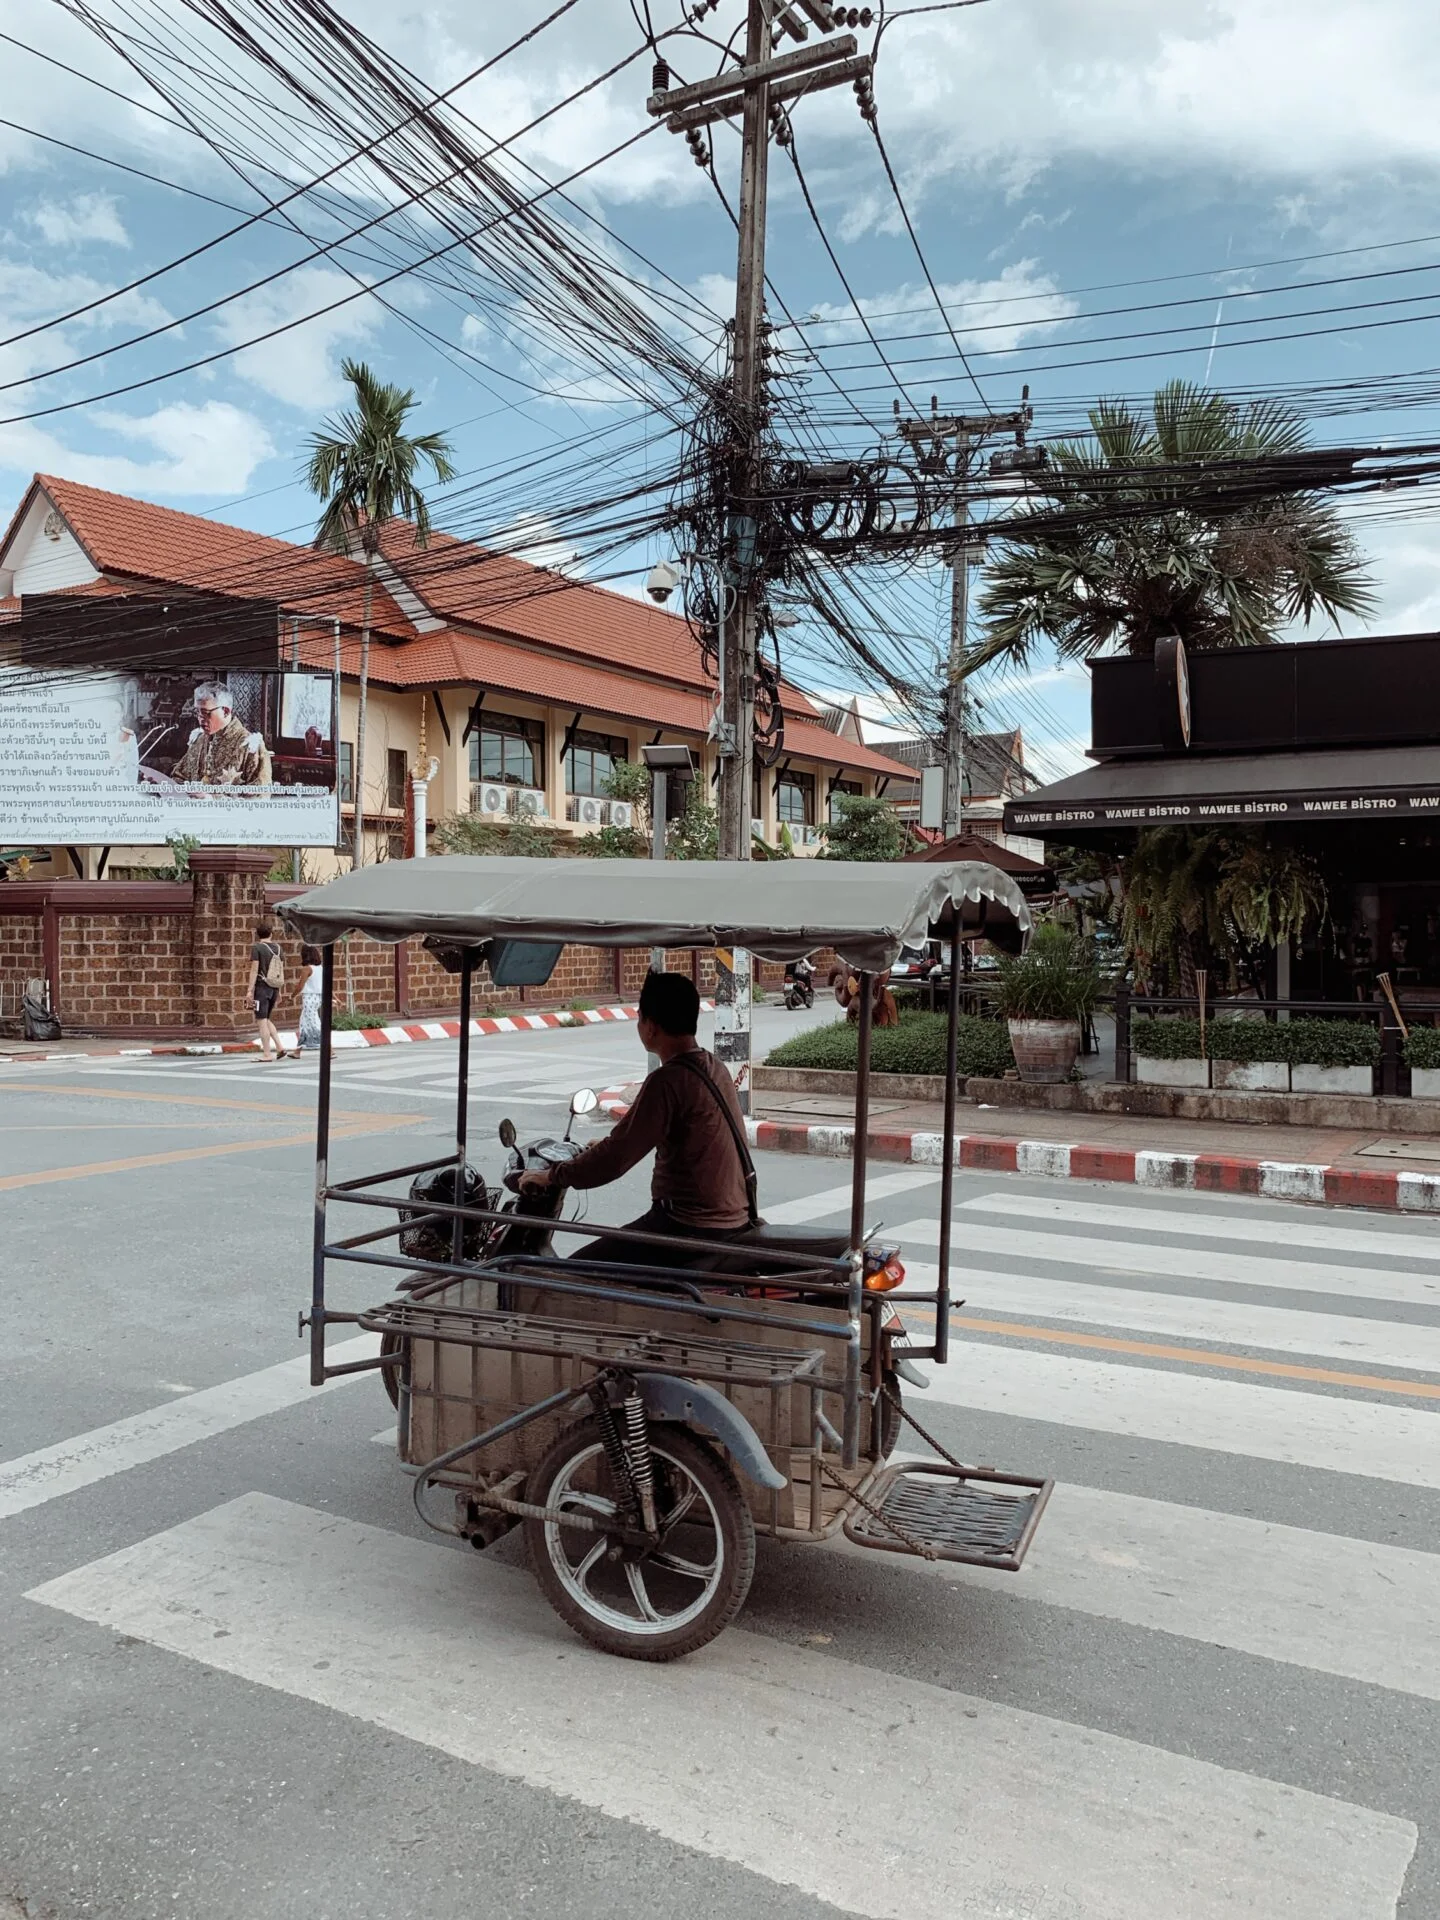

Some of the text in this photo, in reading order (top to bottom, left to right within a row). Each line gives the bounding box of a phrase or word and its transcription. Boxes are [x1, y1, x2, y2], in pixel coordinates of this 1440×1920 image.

[0, 782, 46, 795] ระพุทธเจ้า
[1014, 813, 1053, 824] WAWEE
[1106, 809, 1146, 819] WAWEE
[1199, 805, 1241, 815] WAWEE
[1304, 801, 1348, 811] WAWEE
[1409, 797, 1440, 808] WAW
